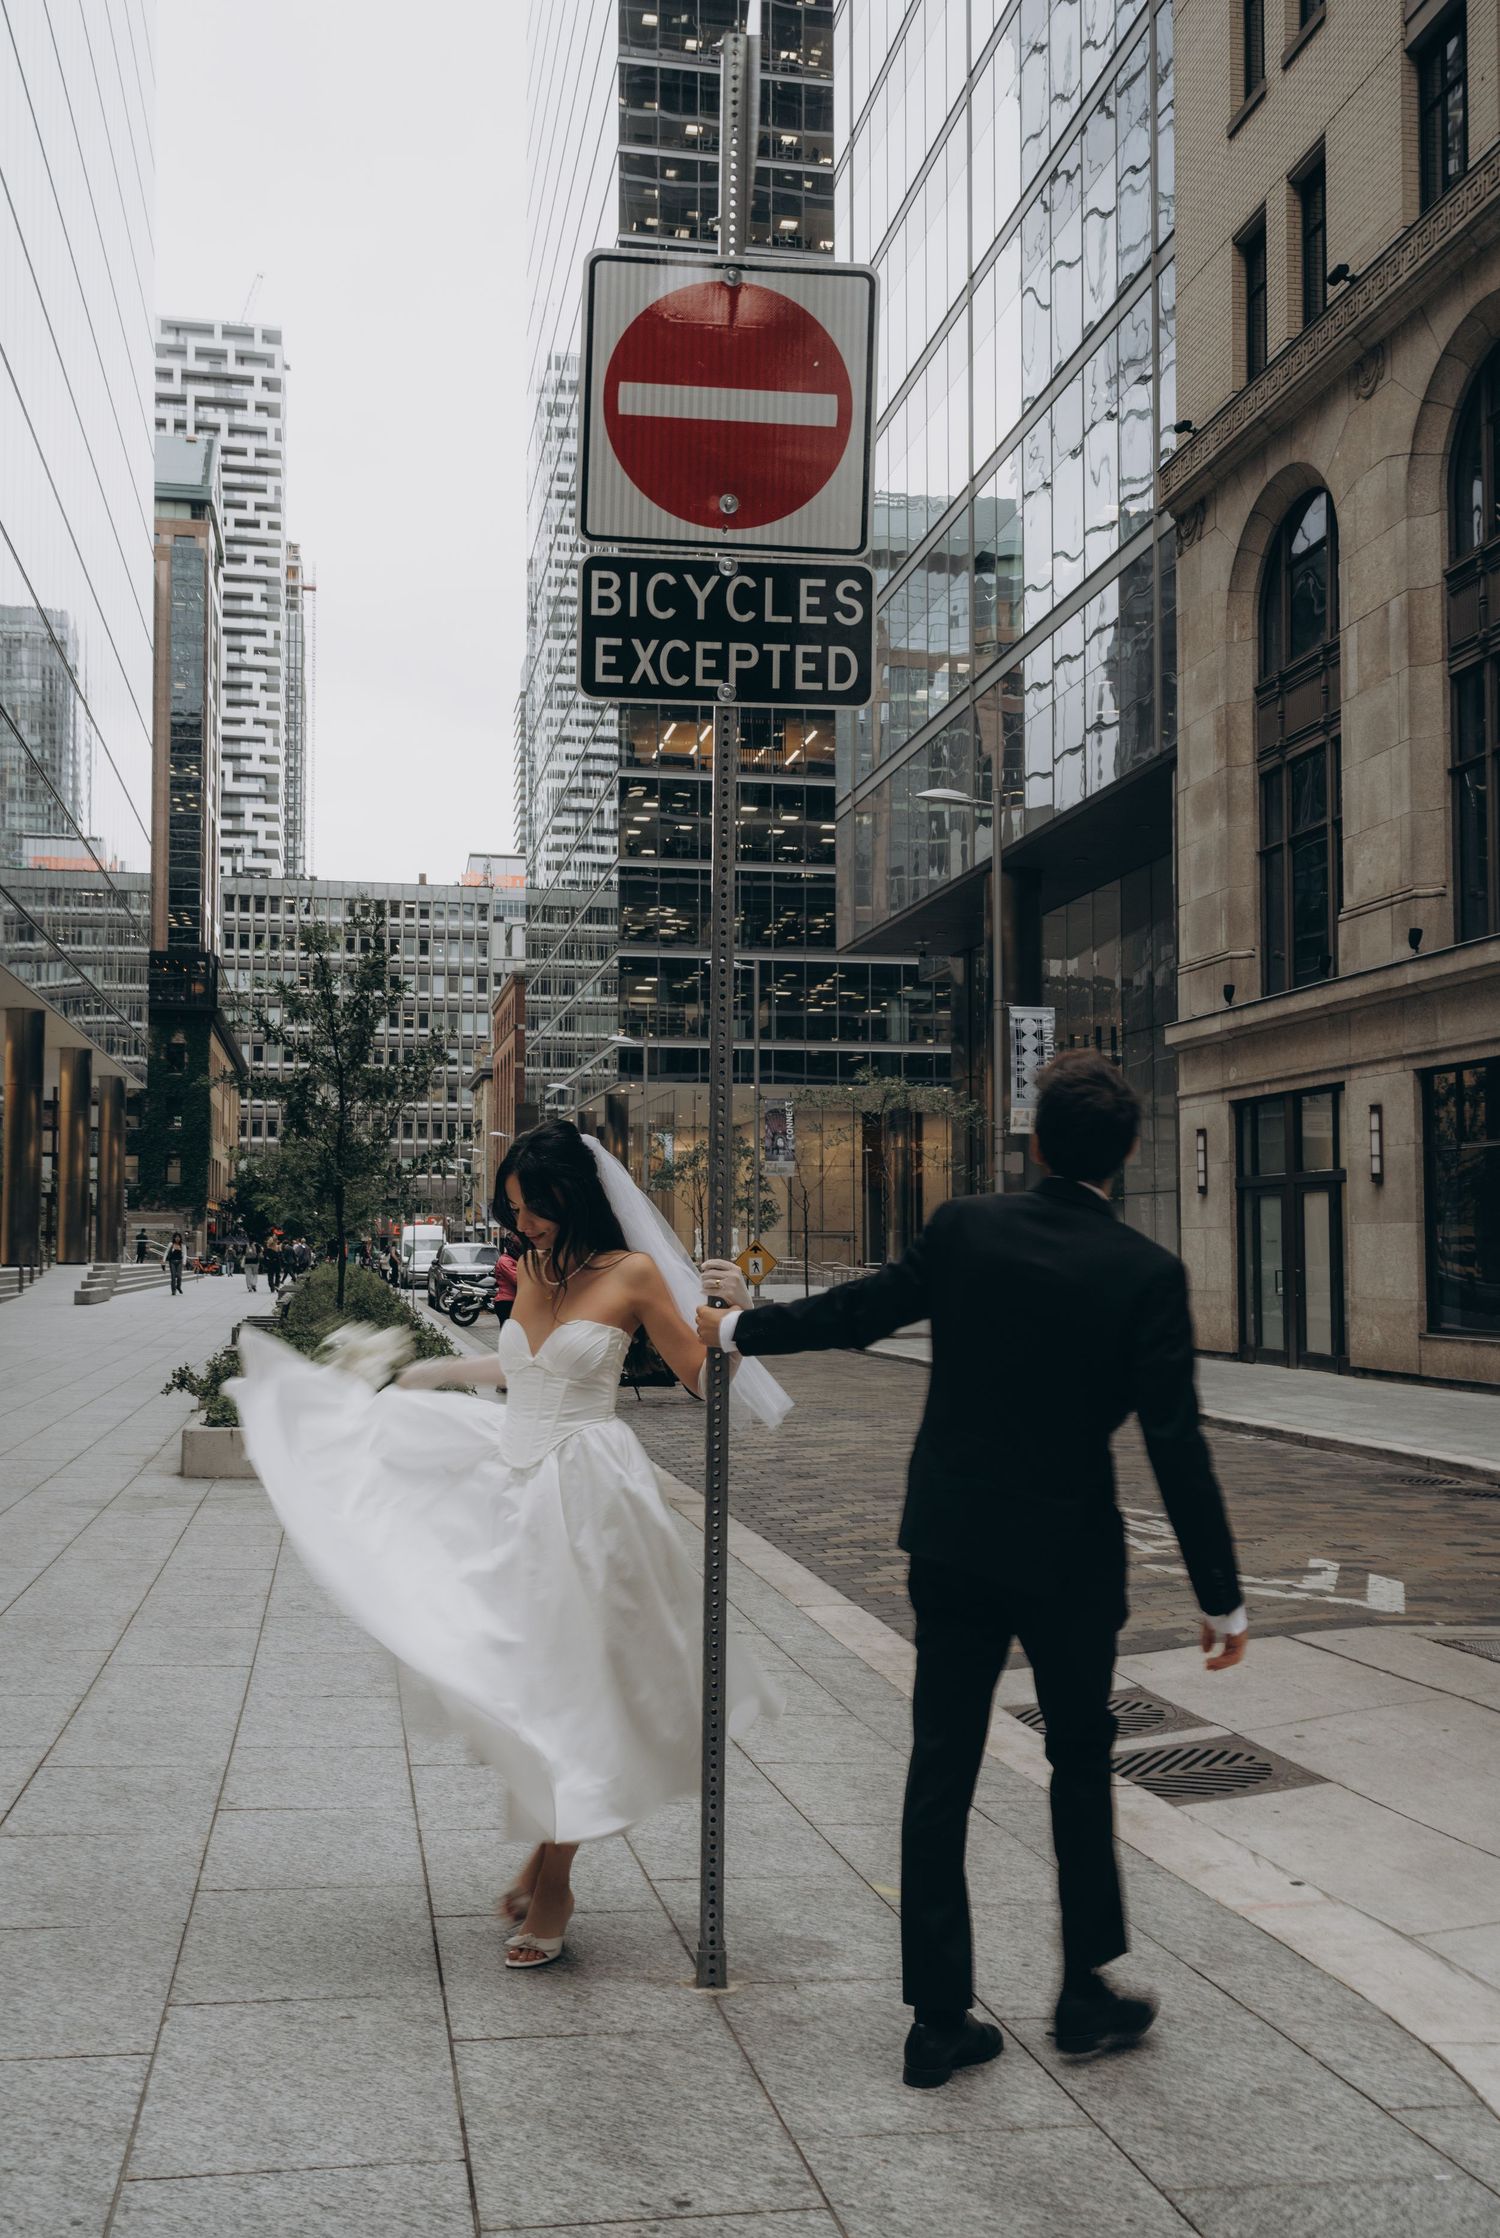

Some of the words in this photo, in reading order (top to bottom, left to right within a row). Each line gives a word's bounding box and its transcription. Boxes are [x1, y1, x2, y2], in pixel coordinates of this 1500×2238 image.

[590, 569, 864, 626] BICYCLES
[594, 636, 859, 692] EXCEPTED
[785, 1101, 794, 1140] CONNECT
